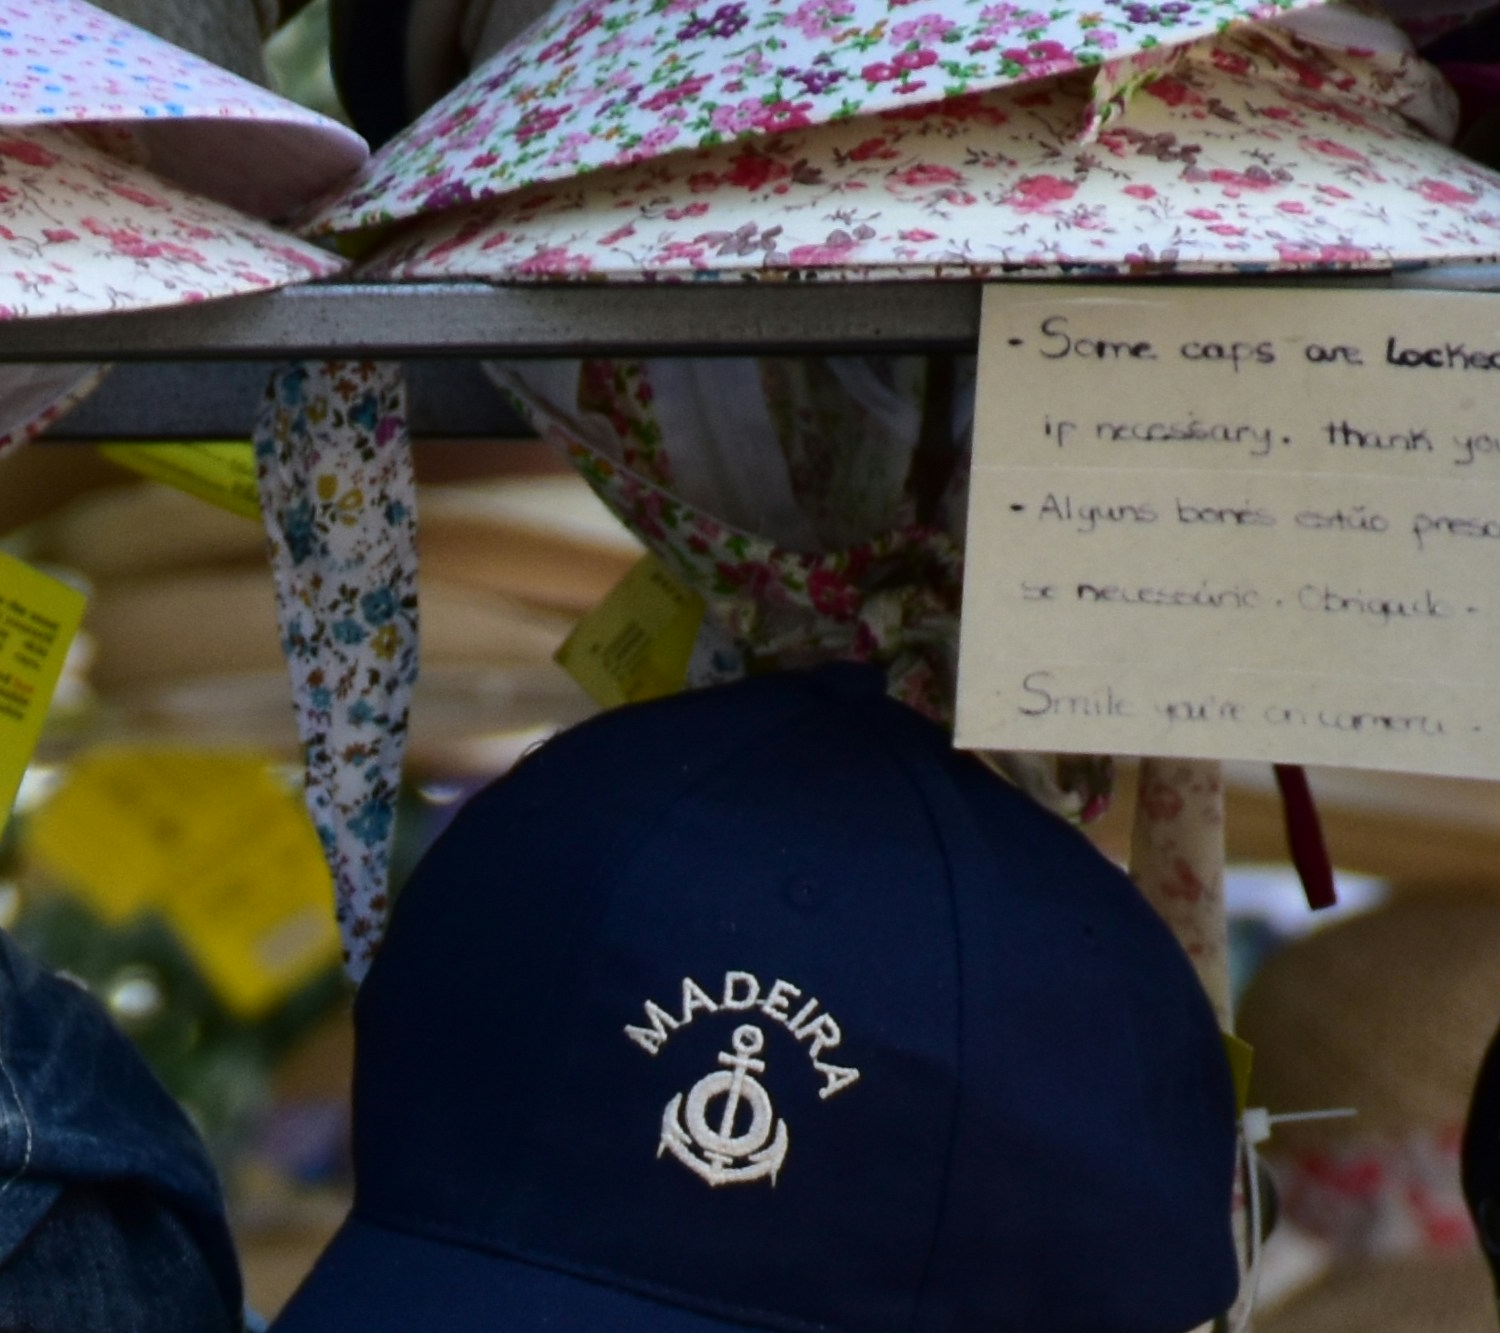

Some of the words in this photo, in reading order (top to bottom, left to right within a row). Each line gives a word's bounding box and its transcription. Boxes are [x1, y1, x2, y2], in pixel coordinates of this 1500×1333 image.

[1040, 315, 1157, 360] Some
[1180, 340, 1276, 372] caps
[1304, 342, 1364, 366] are
[1038, 492, 1160, 533] Alguns
[1016, 669, 1131, 718] Smile
[623, 970, 861, 1100] MADEIRA
